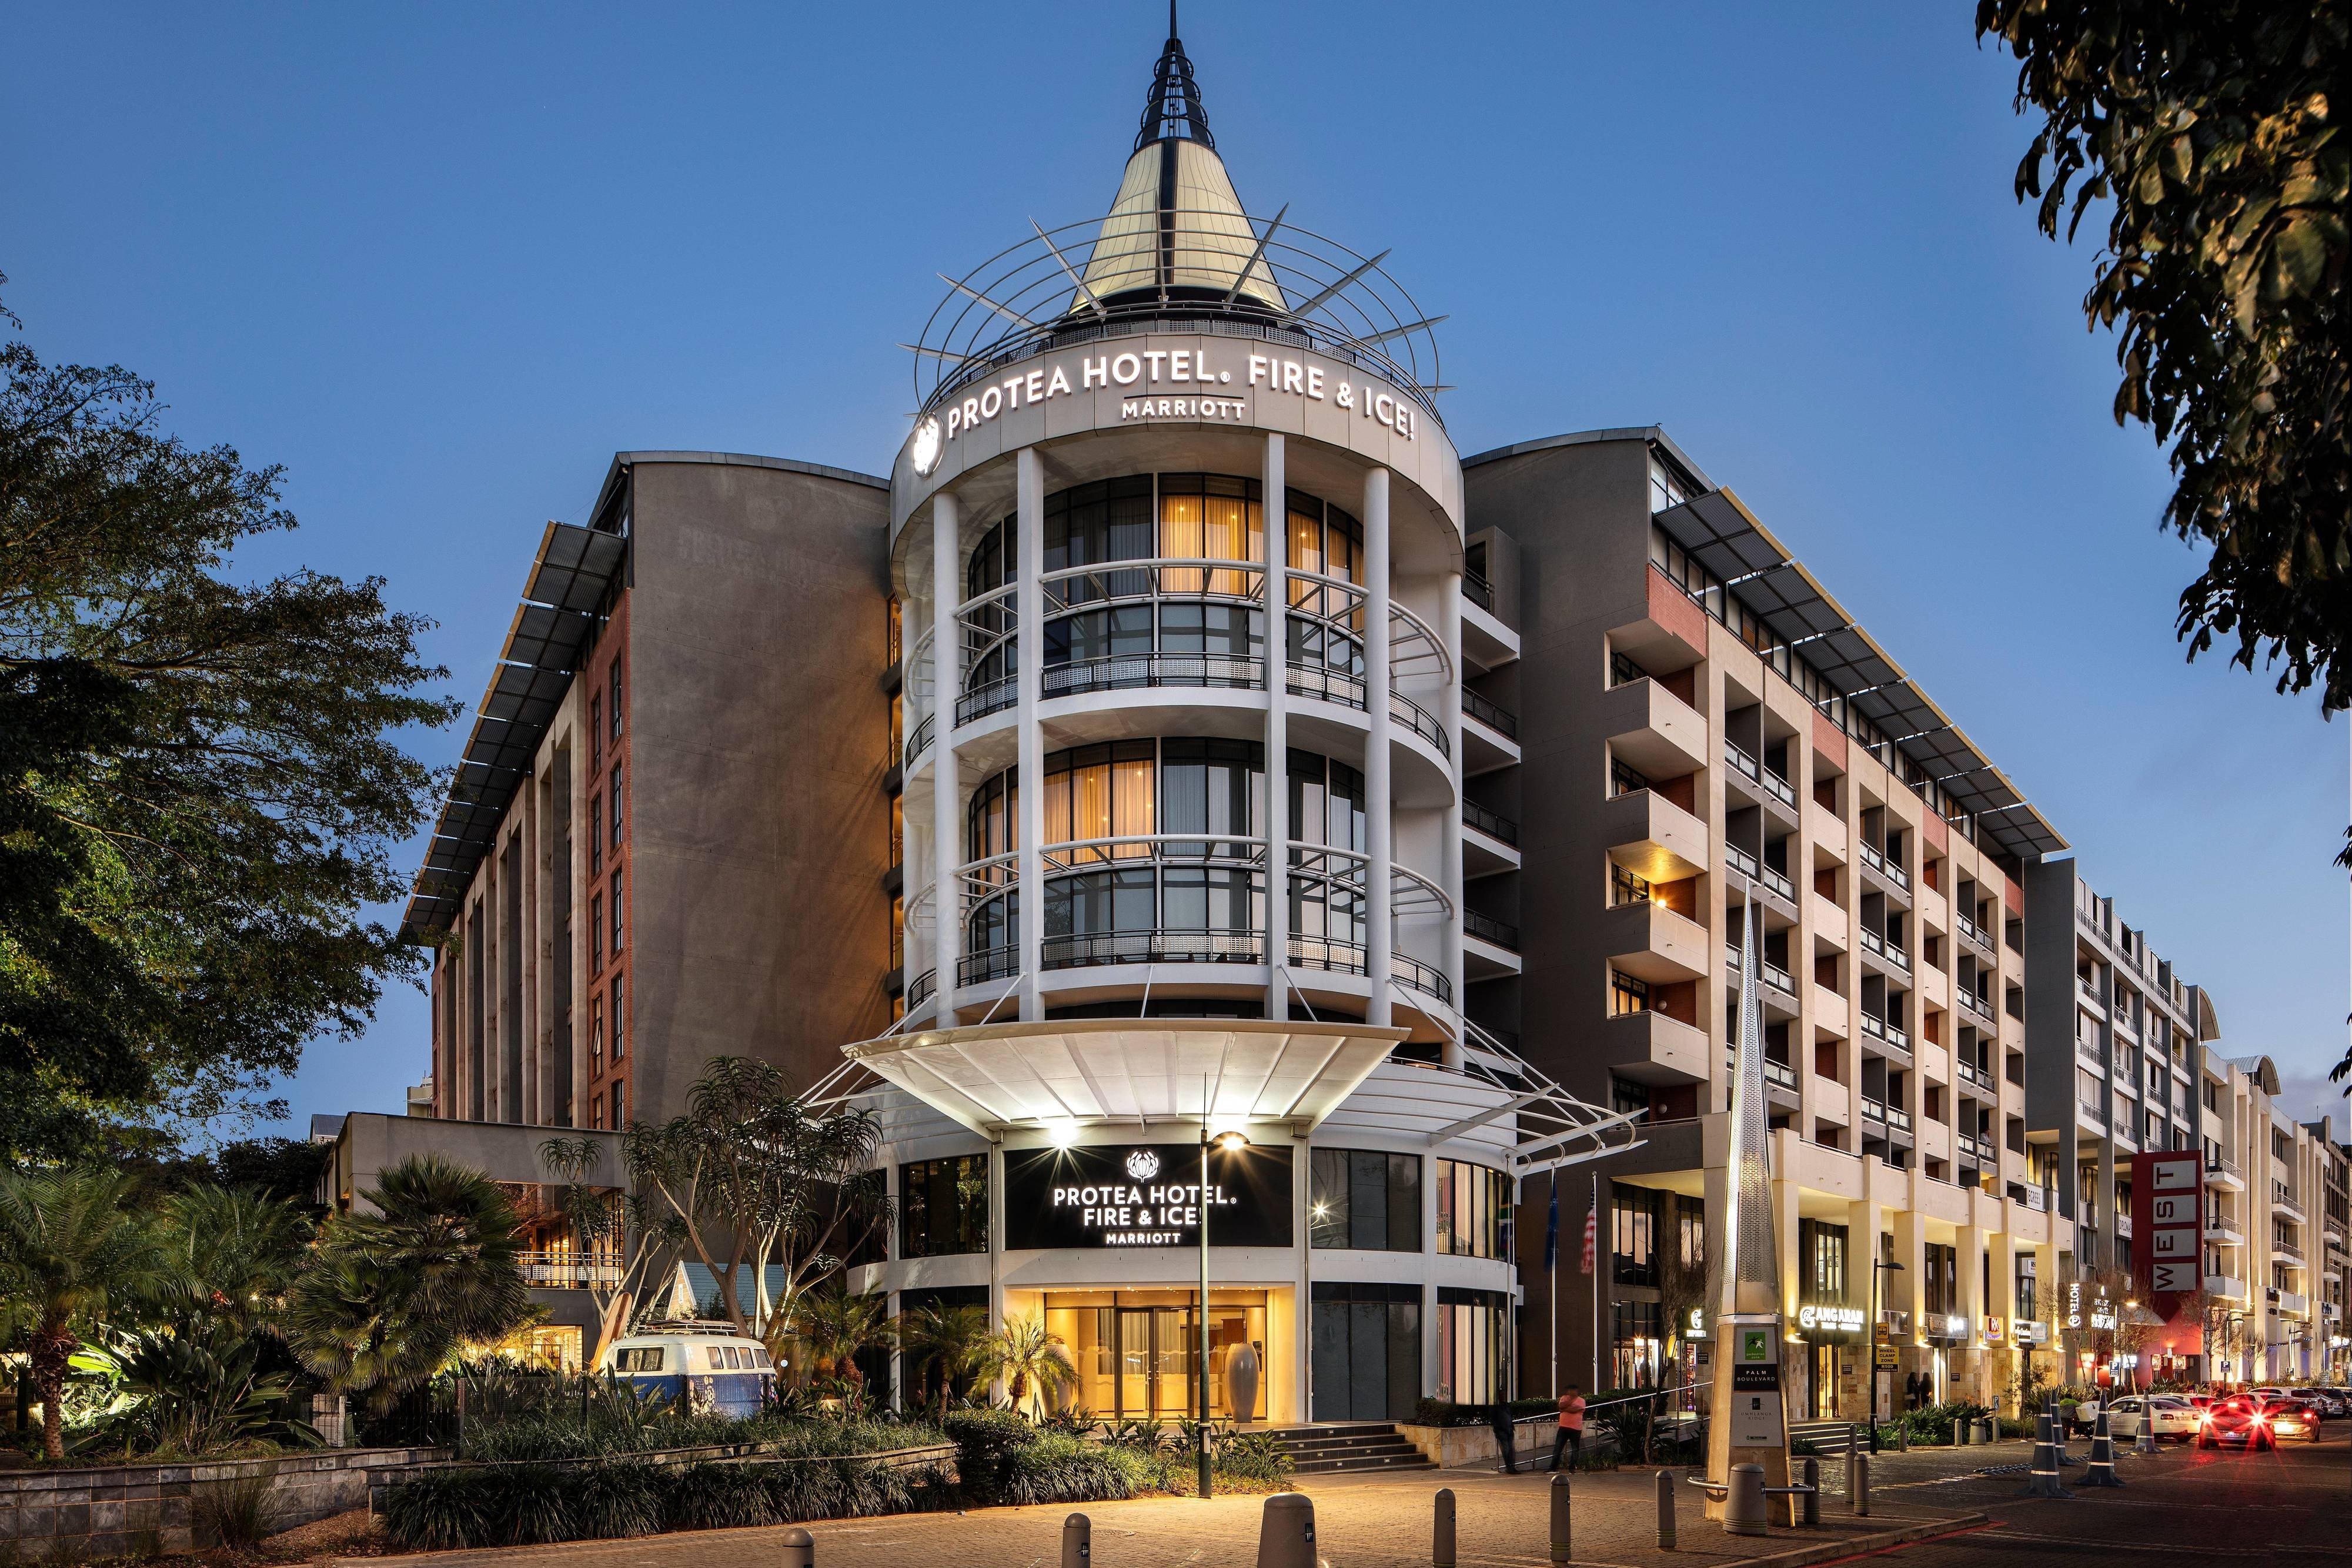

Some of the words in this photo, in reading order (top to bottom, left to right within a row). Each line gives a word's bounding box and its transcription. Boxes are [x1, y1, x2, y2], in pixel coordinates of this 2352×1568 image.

[948, 366, 1073, 440] PROTEA
[1248, 354, 1325, 402] FIRE
[1337, 382, 1357, 410] &
[1365, 386, 1416, 441] ICE!
[1122, 399, 1246, 420] MARRIOTT
[1054, 1185, 1143, 1206] PROTEA
[1084, 1207, 1131, 1226] FIRE
[1138, 1210, 1152, 1225] &
[1161, 1207, 1202, 1225] ICE!
[1106, 1232, 1181, 1245] MARRIOTT
[2156, 1167, 2174, 1290] WEST
[2070, 1283, 2079, 1315] HOTEL
[2112, 1362, 2117, 1370] P
